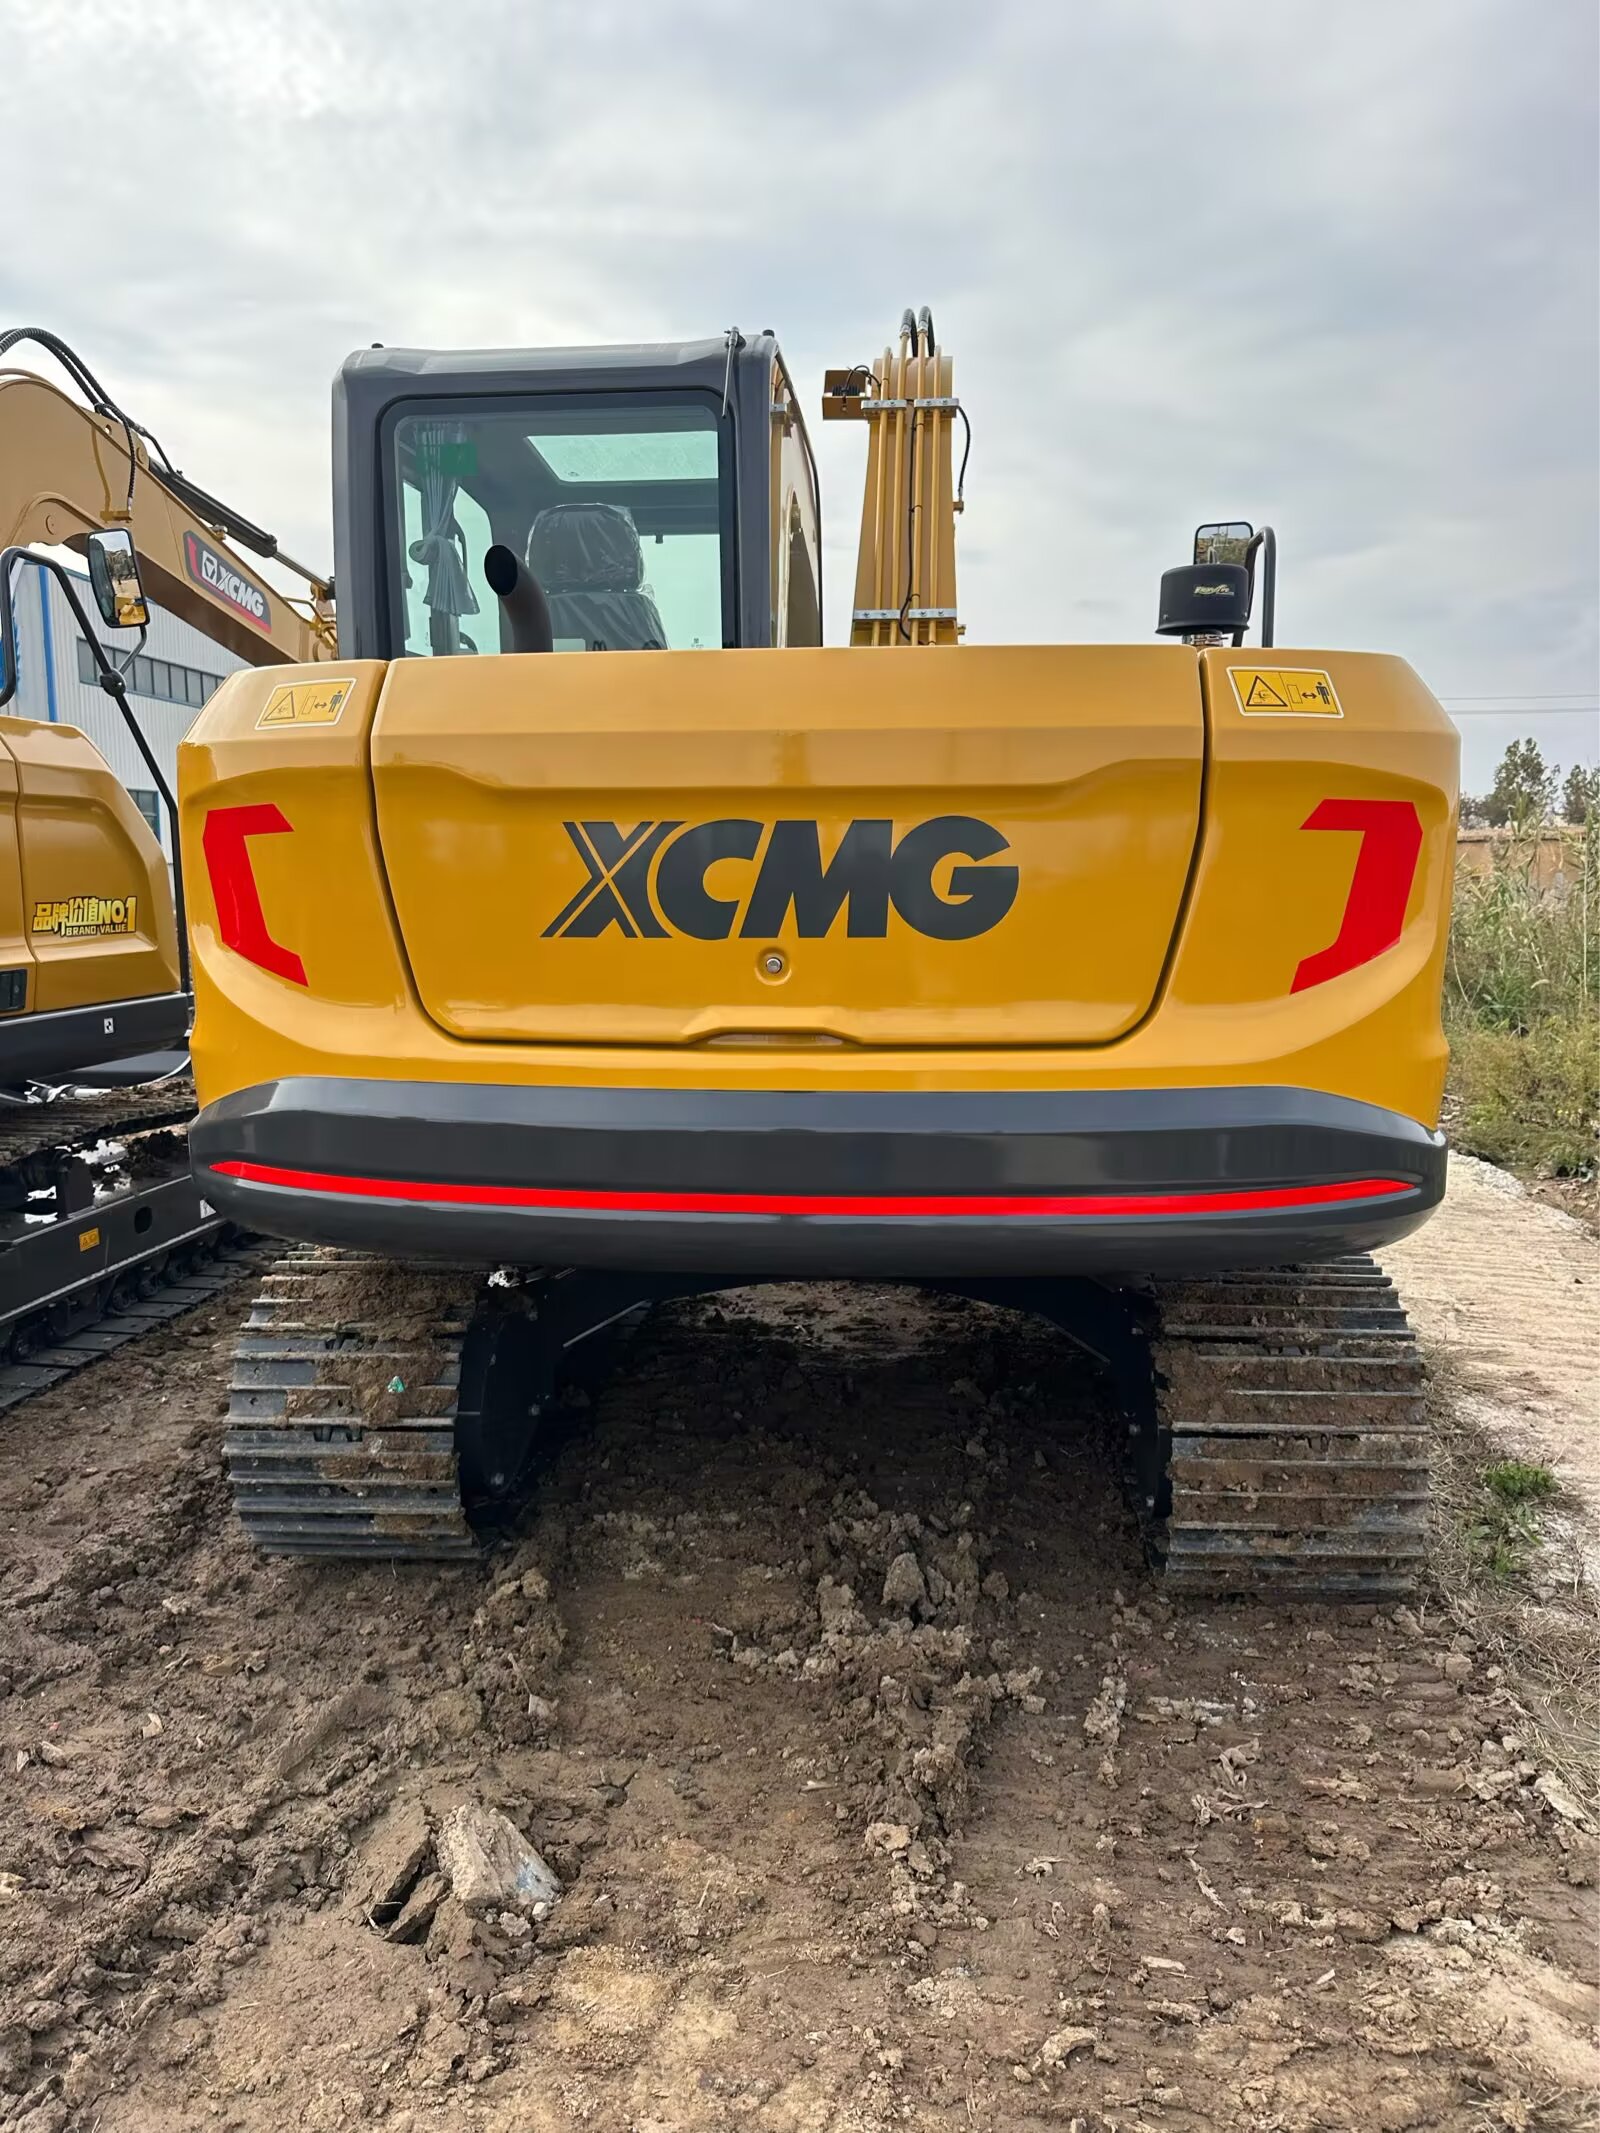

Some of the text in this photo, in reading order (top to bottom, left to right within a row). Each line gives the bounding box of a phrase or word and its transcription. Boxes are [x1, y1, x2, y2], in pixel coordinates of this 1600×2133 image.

[216, 565, 264, 617] XCMG
[540, 815, 1019, 941] XCMG
[66, 924, 127, 936] BRAND VALUE
